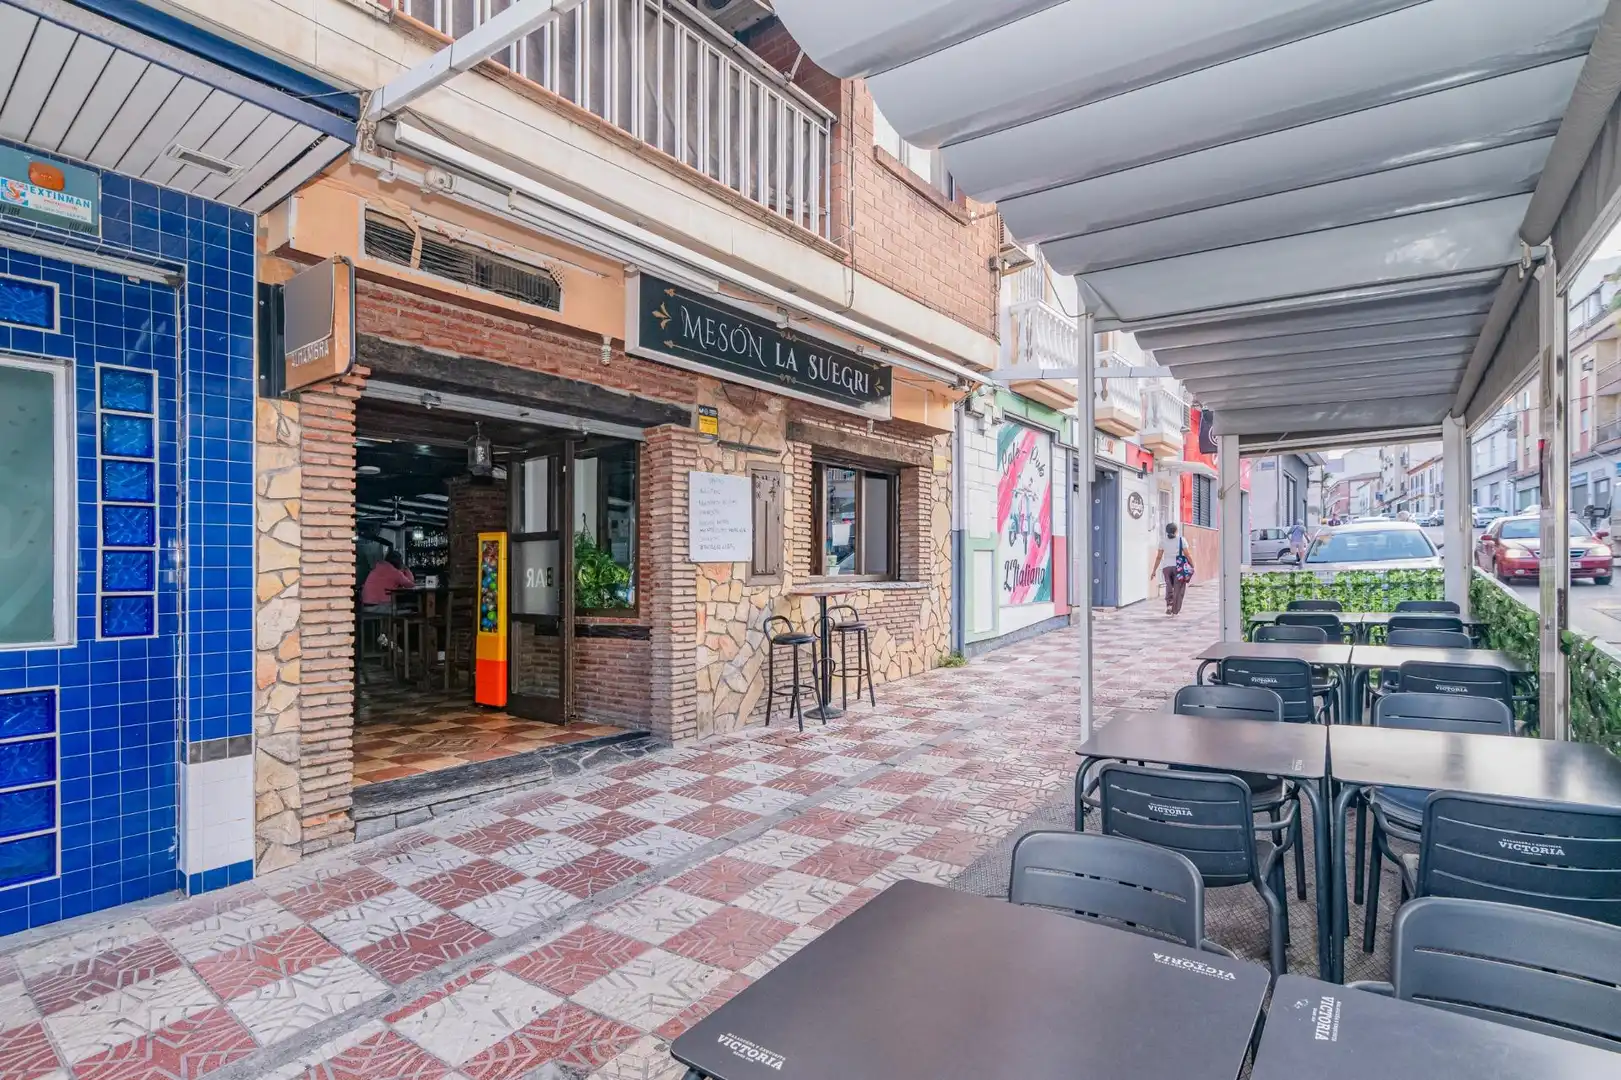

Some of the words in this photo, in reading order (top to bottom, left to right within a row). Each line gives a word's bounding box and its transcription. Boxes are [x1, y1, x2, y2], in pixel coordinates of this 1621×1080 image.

[30, 186, 91, 209] EXTINMAN
[680, 305, 767, 368] MESÓN
[775, 342, 799, 373] LA
[807, 354, 869, 396] SUEGRI
[1148, 804, 1193, 817] VICTORIA
[1498, 840, 1566, 856] VICTORIA
[1153, 952, 1236, 980] VICTORIA
[1314, 996, 1334, 1041] VICTORIA
[717, 1034, 783, 1071] VICTORIA
